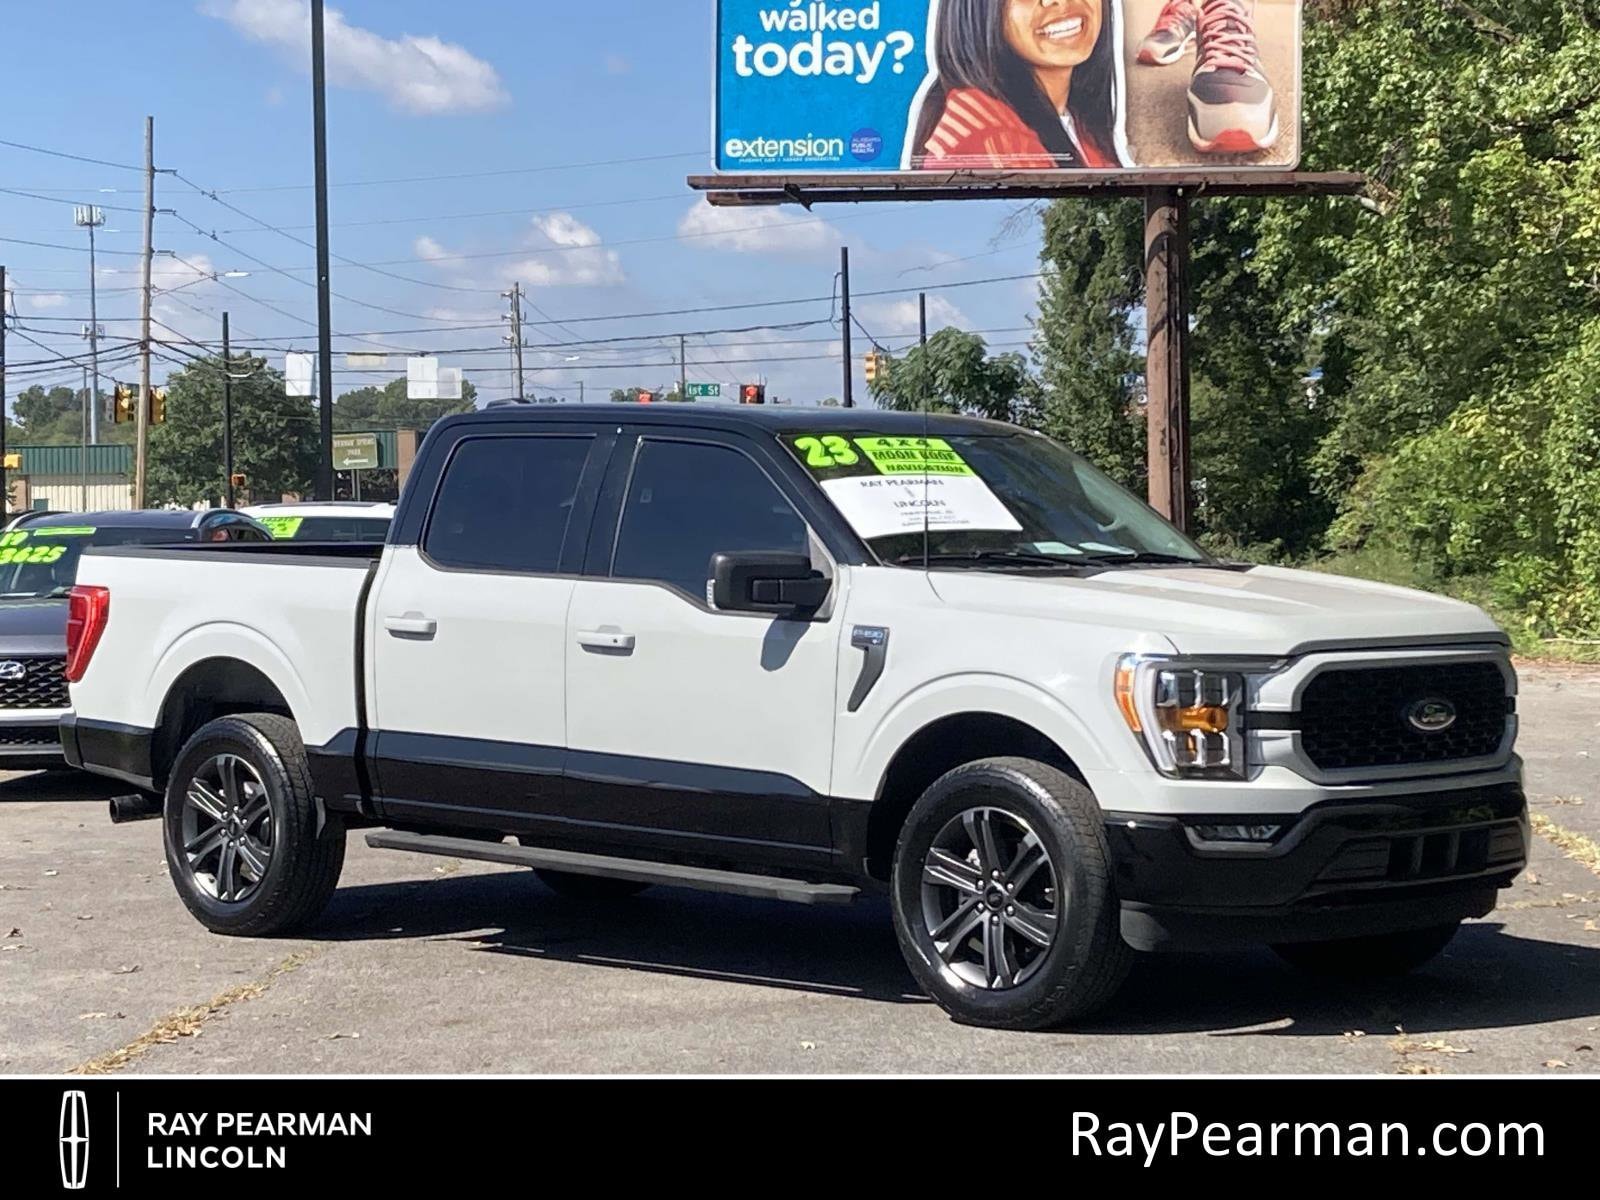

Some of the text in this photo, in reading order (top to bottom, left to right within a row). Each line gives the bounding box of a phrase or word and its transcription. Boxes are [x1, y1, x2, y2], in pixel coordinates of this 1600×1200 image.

[759, 1, 880, 32] walked
[732, 31, 914, 84] today?
[725, 132, 844, 158] extension
[707, 385, 719, 395] St
[795, 436, 859, 467] 23
[872, 449, 957, 461] MOON ROOF
[886, 464, 967, 474] NAVIGATION
[860, 479, 945, 488] RAY PEARMAN
